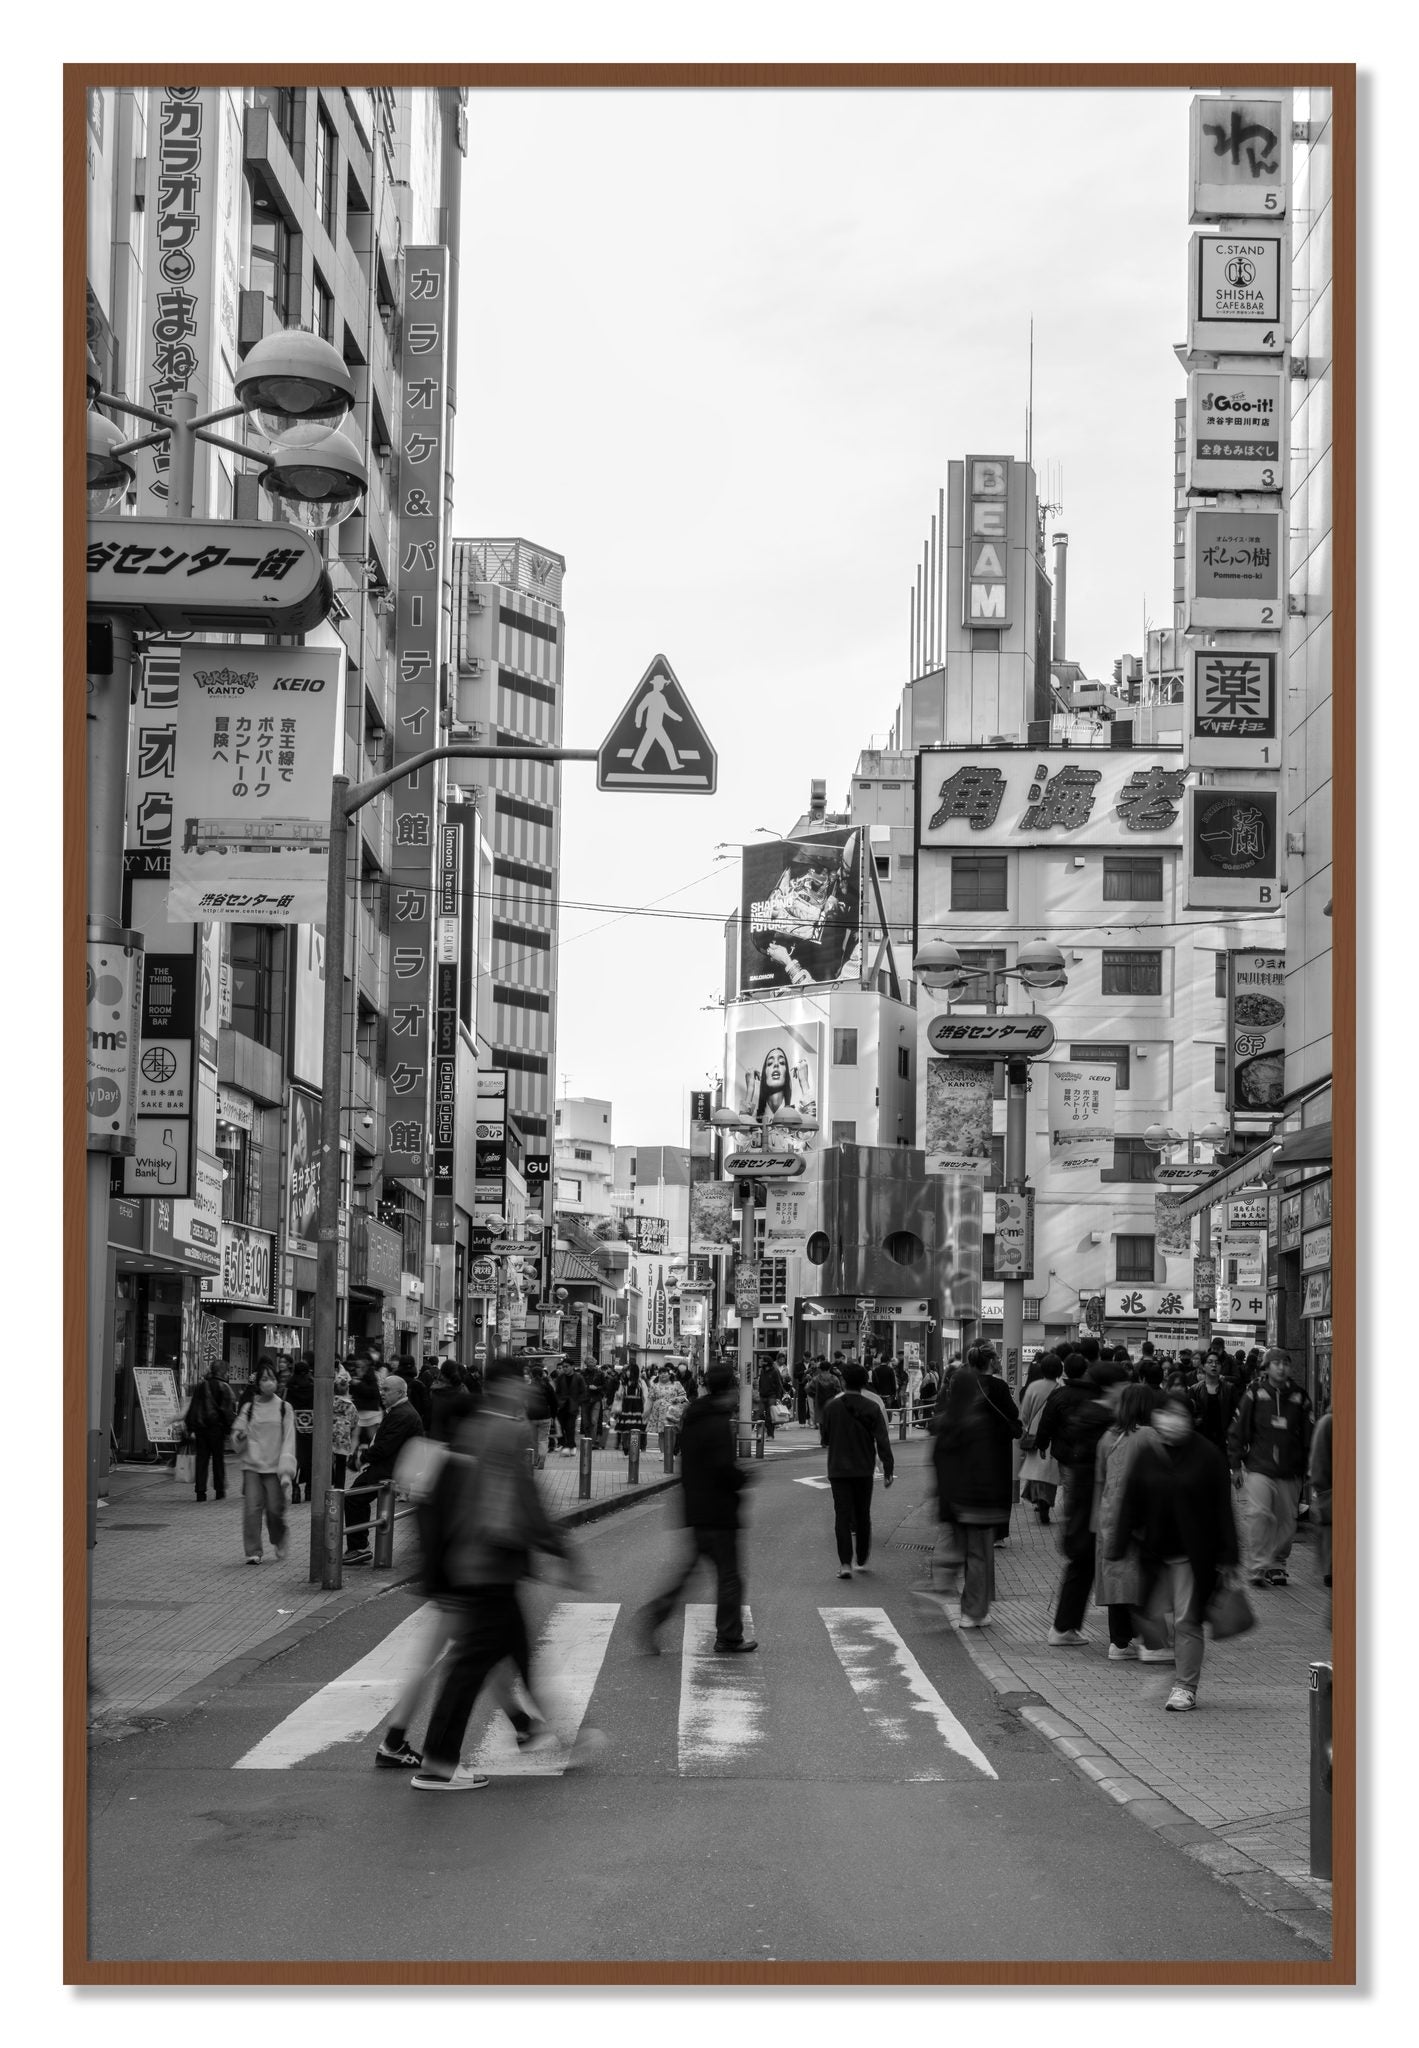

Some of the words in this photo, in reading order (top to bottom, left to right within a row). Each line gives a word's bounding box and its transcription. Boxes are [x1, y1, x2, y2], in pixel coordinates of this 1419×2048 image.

[157, 102, 203, 251] カラオケ
[1264, 193, 1278, 210] 5
[1216, 245, 1265, 256] C.STAND
[1216, 289, 1265, 301] SHISHA
[1216, 301, 1264, 310] CAFE&BAR
[1263, 331, 1276, 348] 4
[1214, 395, 1274, 413] Goo-it!
[1207, 416, 1270, 427] 渋谷宇田川町店
[1201, 444, 1275, 457] 全身もみほぐし
[1261, 468, 1275, 487] 3
[970, 461, 1006, 618] BEAM
[1202, 546, 1272, 567] ポムの樹
[1261, 607, 1274, 624] 2
[207, 687, 245, 695] KANTO
[273, 678, 326, 693] KEIO
[1206, 660, 1261, 715] 薬
[1200, 719, 1267, 734] マツモトキヨシ
[212, 716, 230, 763] 冒険へ
[232, 716, 252, 798] カントーの
[254, 716, 275, 798] ポケパーク
[278, 717, 297, 783] 京王線で
[1260, 746, 1270, 763] 1
[928, 764, 1185, 831] 角海老
[1200, 808, 1266, 859] 一蘭
[446, 829, 455, 868] kimono
[199, 893, 295, 907] 渋谷センター街
[1260, 886, 1272, 903] B
[1237, 972, 1286, 985] 四川料理
[149, 1006, 172, 1014] ROOM
[152, 1018, 168, 1026] BAR
[935, 1024, 1048, 1041] 渋谷センター街
[1234, 1034, 1267, 1056] 6F
[136, 1158, 172, 1170] Whisky
[527, 1162, 549, 1173] GU
[728, 1159, 796, 1169] 渋谷センター街
[136, 1169, 157, 1177] Bank
[1158, 1170, 1220, 1178] 渋谷センター街
[474, 1266, 492, 1274] 消火栓
[646, 1263, 654, 1345] SHIBUYA
[1120, 1291, 1185, 1315] 兆楽
[656, 1290, 665, 1336] BEER
[652, 1337, 666, 1345] HALL
